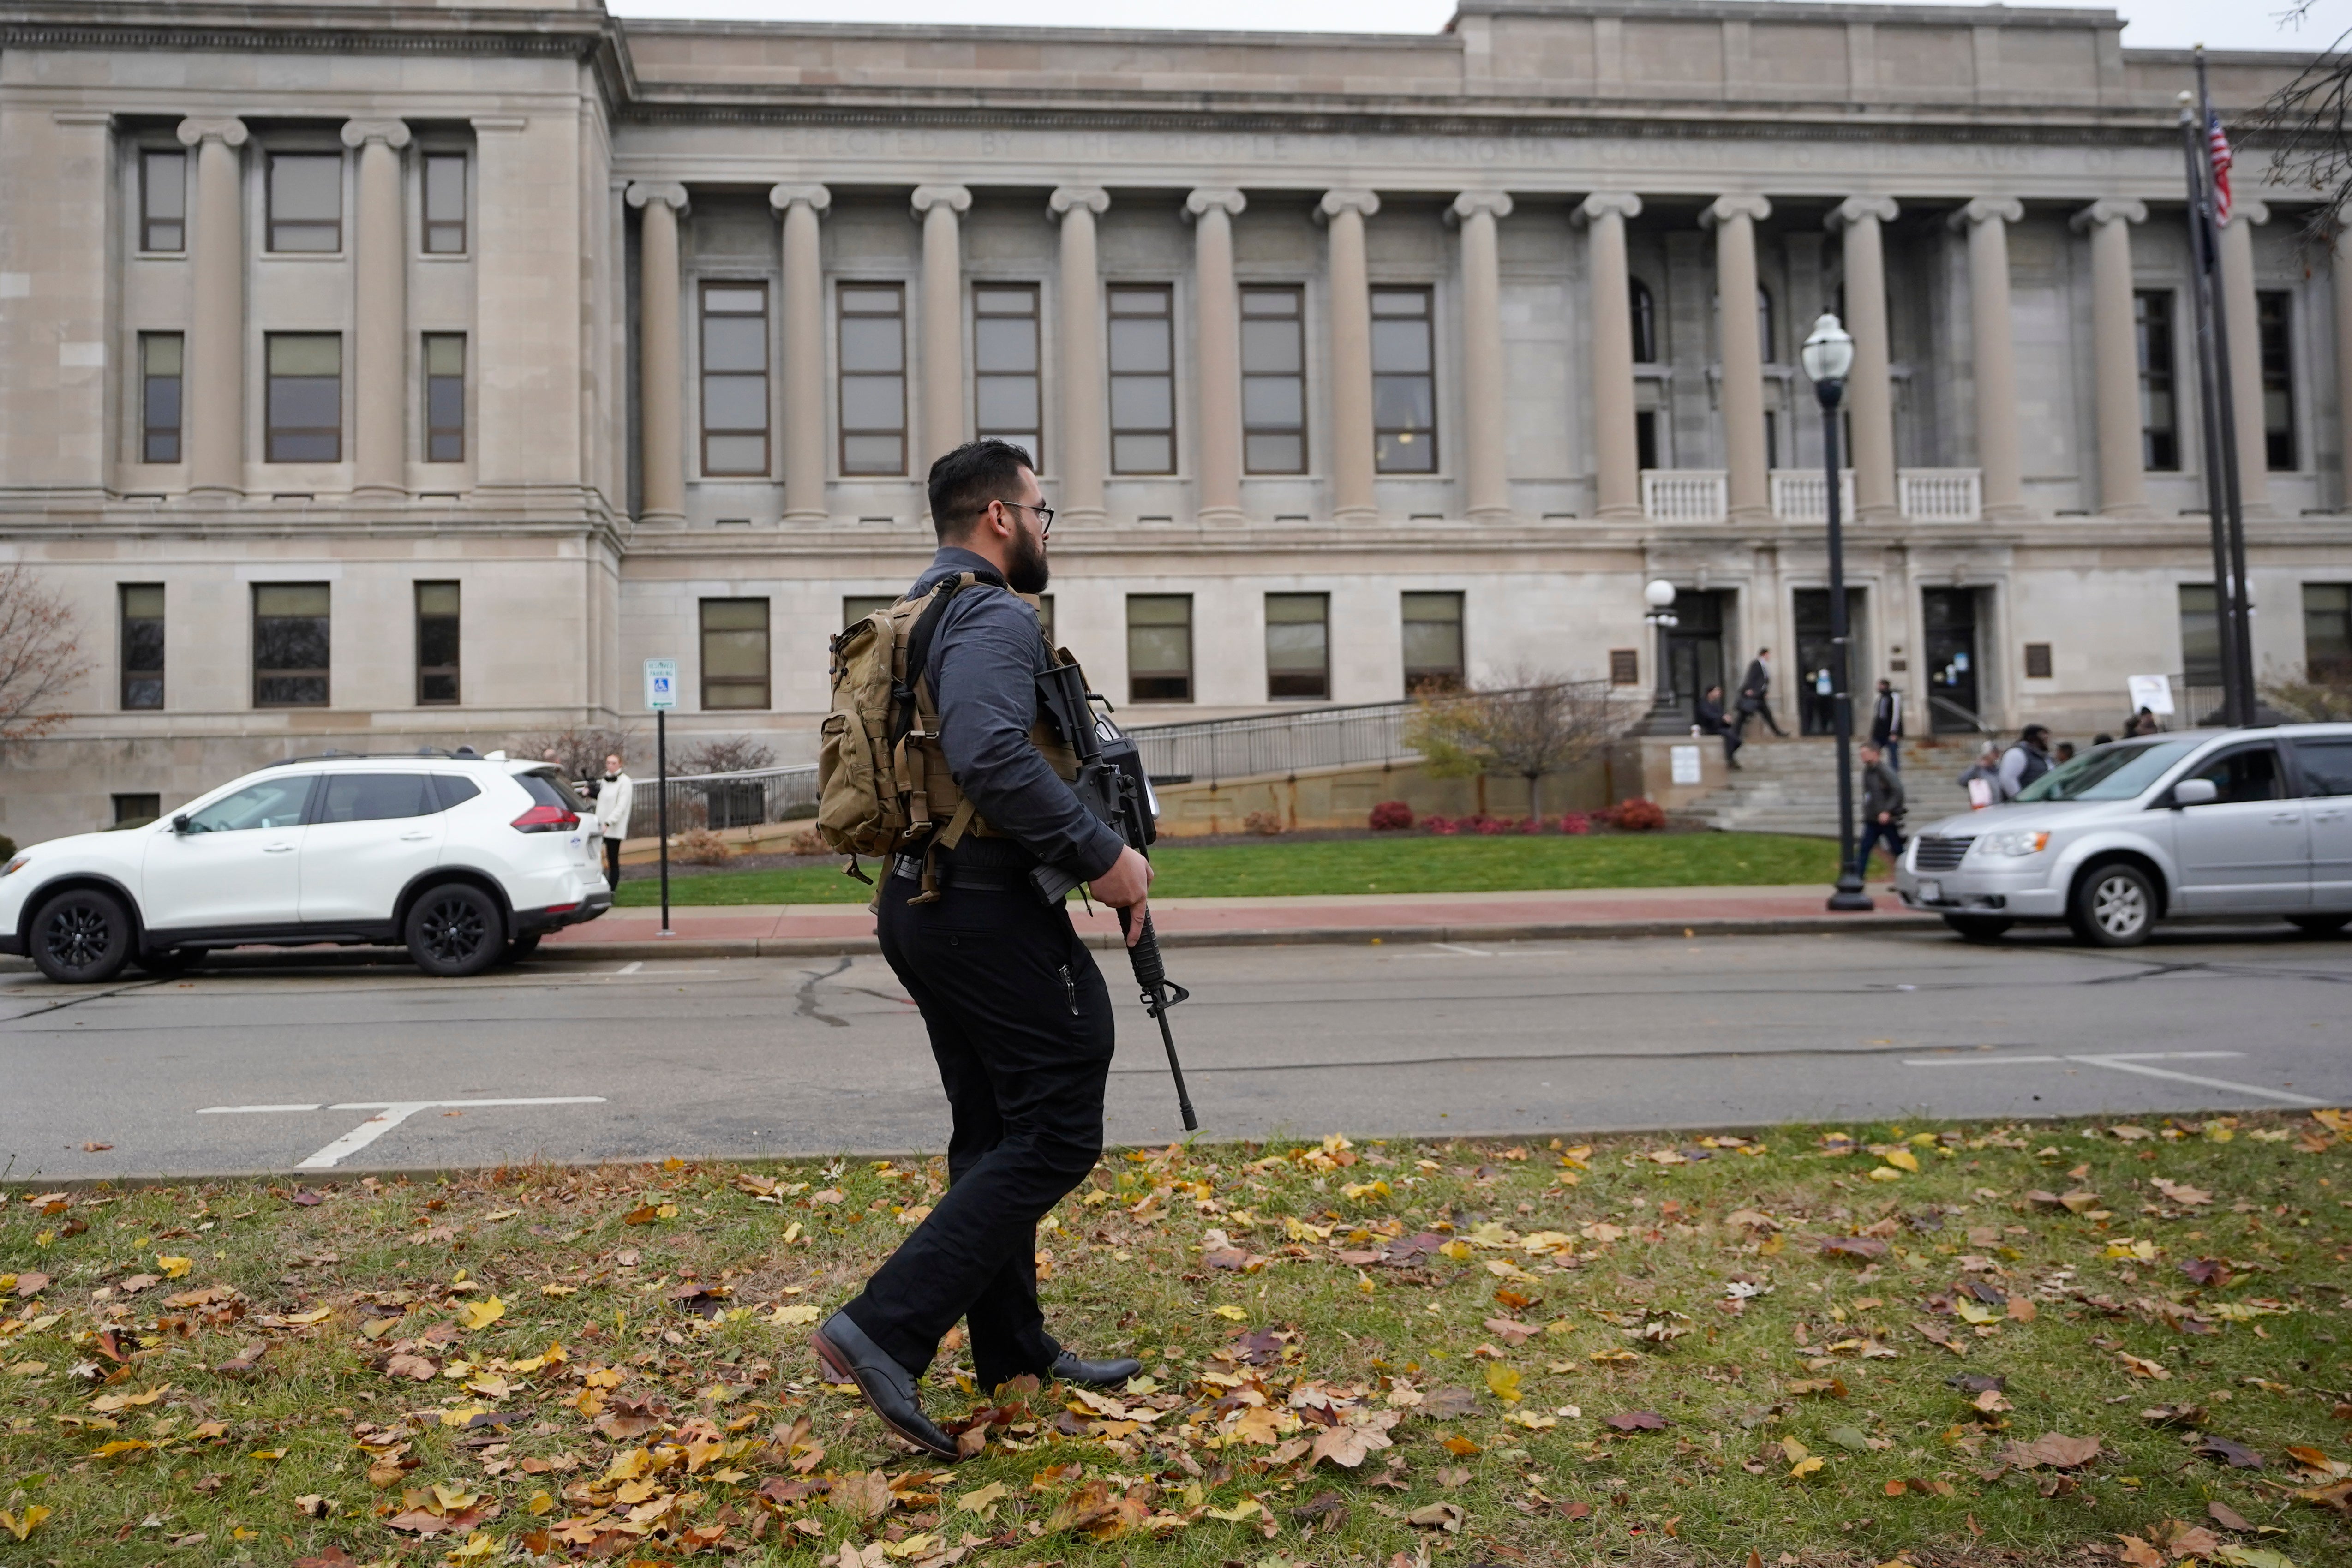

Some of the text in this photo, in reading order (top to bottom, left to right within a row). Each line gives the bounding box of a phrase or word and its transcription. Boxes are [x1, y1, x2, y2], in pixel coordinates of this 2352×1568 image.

[781, 130, 940, 155] ERECTED
[981, 132, 1015, 156] BY
[1065, 133, 1123, 157] THE
[1163, 134, 1288, 159] PEOPLE
[1329, 136, 1370, 161] OF
[1411, 138, 1557, 163] KENOSHA
[1598, 140, 1726, 166] COUNTY
